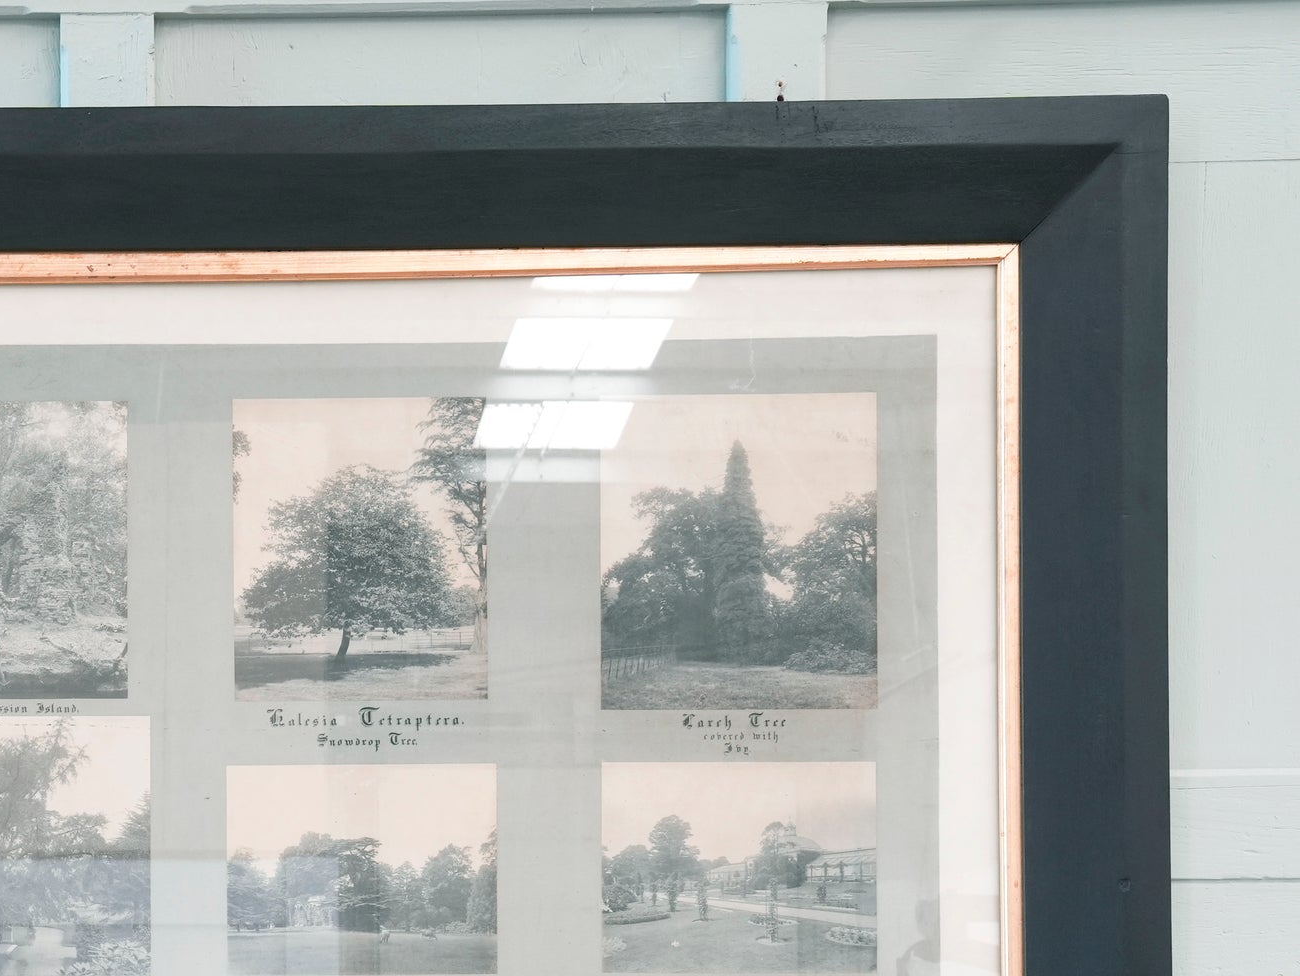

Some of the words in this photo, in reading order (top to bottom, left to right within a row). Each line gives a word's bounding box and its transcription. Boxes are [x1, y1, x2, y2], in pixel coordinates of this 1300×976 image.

[358, 706, 465, 731] Tetraptera.
[682, 713, 732, 730] Larch
[748, 712, 786, 728] Tree
[317, 733, 381, 752] Snowdrop
[703, 732, 745, 741] covered
[752, 731, 779, 743] with
